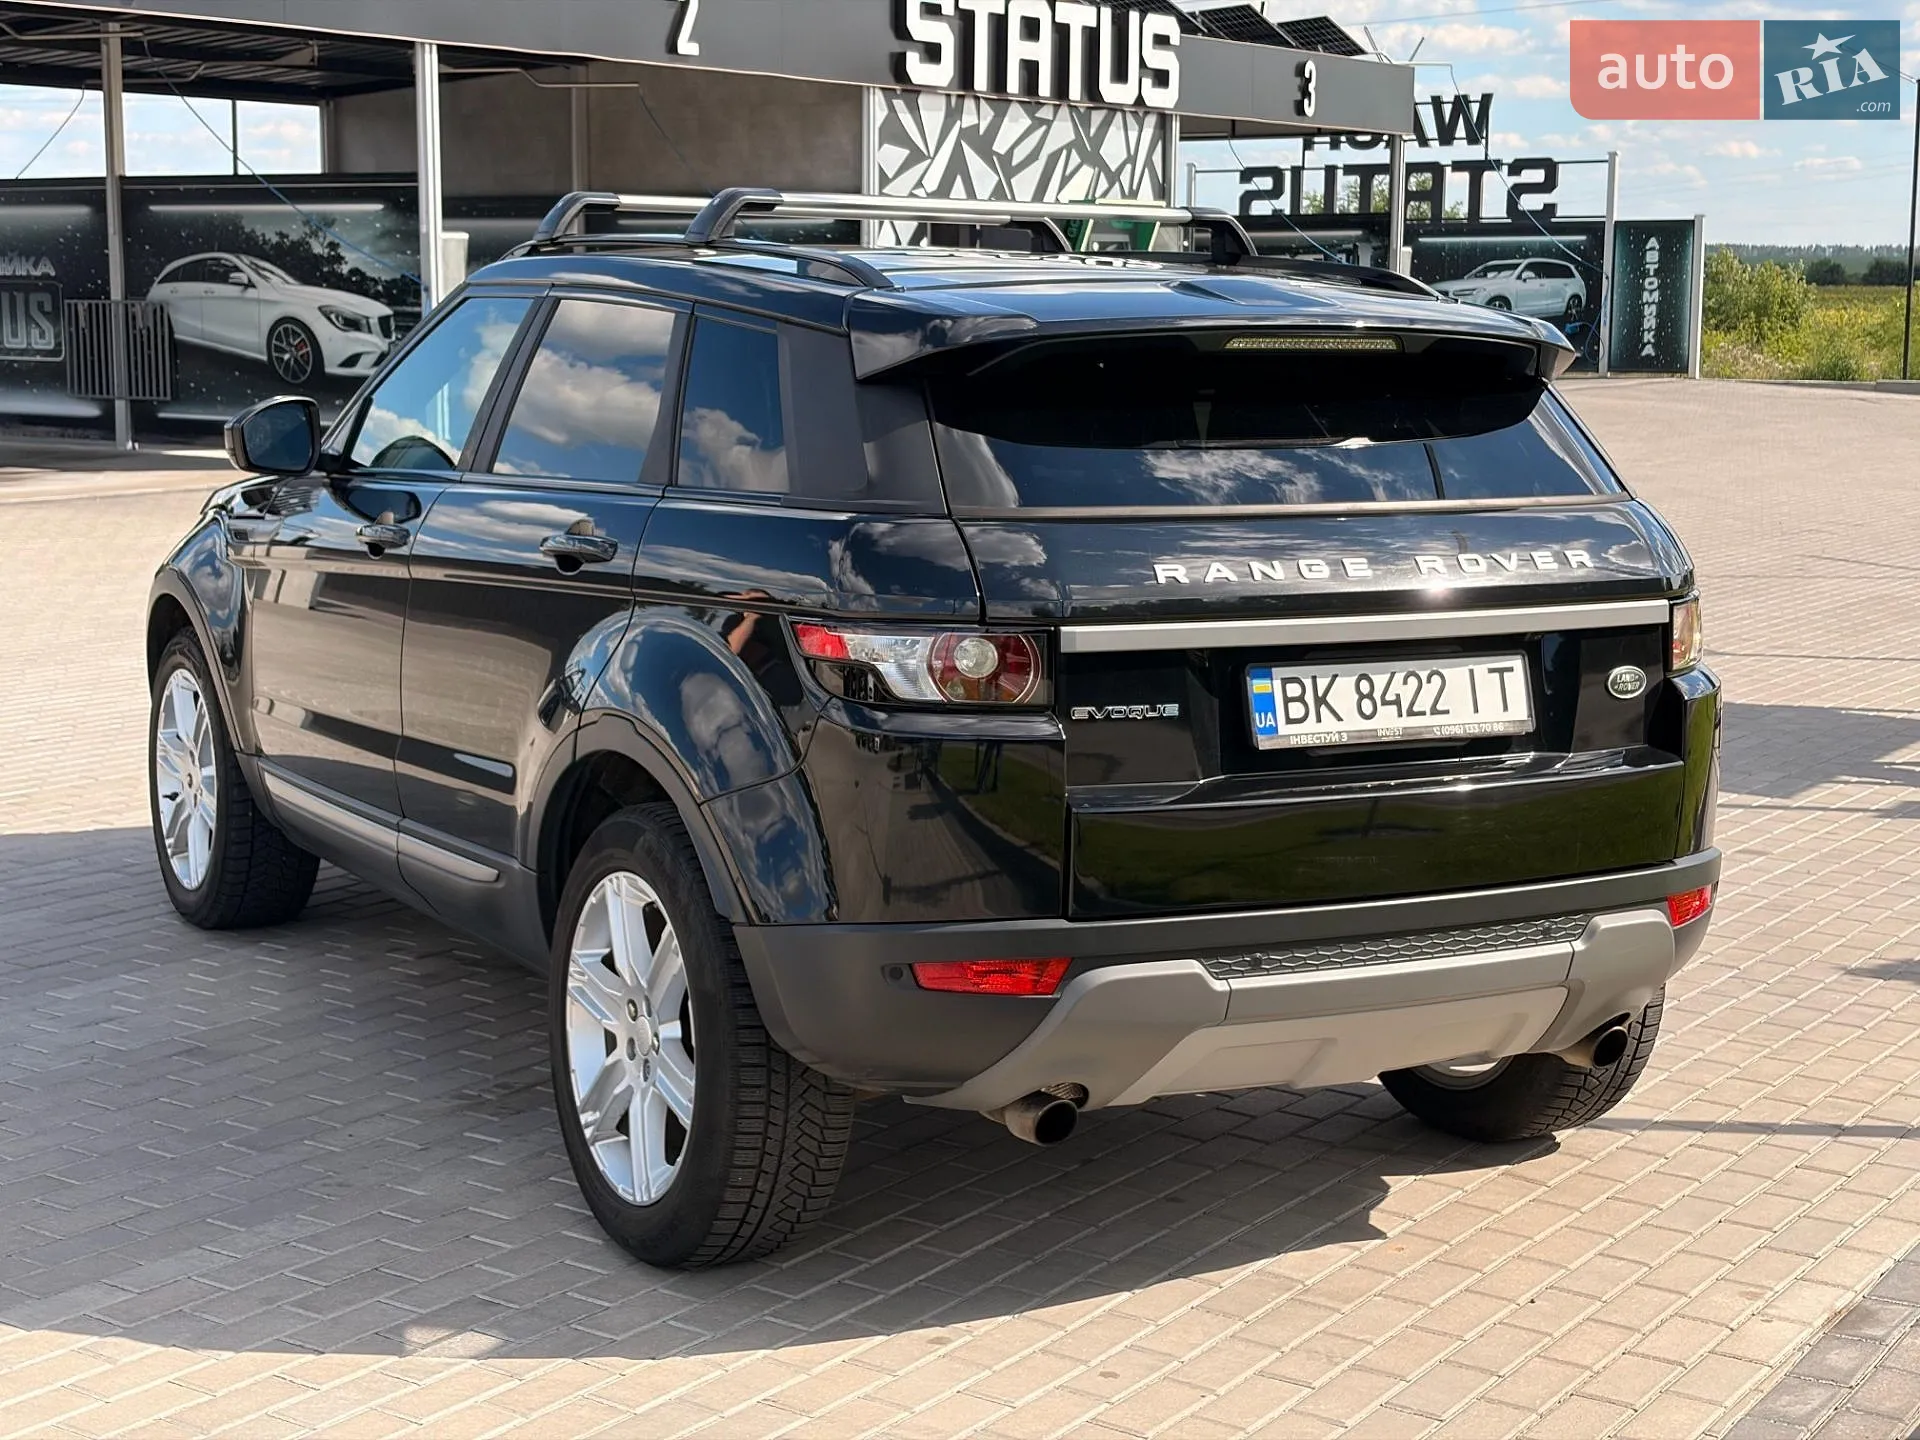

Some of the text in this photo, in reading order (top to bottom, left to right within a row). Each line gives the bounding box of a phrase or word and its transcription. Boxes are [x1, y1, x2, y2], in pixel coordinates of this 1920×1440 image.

[905, 0, 1181, 109] STATUS
[1303, 60, 1317, 118] 3
[1153, 549, 1595, 585] RANGE ROVER
[1071, 703, 1180, 720] EVOQUE
[1280, 665, 1514, 725] BK 8422 IT
[1255, 712, 1276, 728] UA
